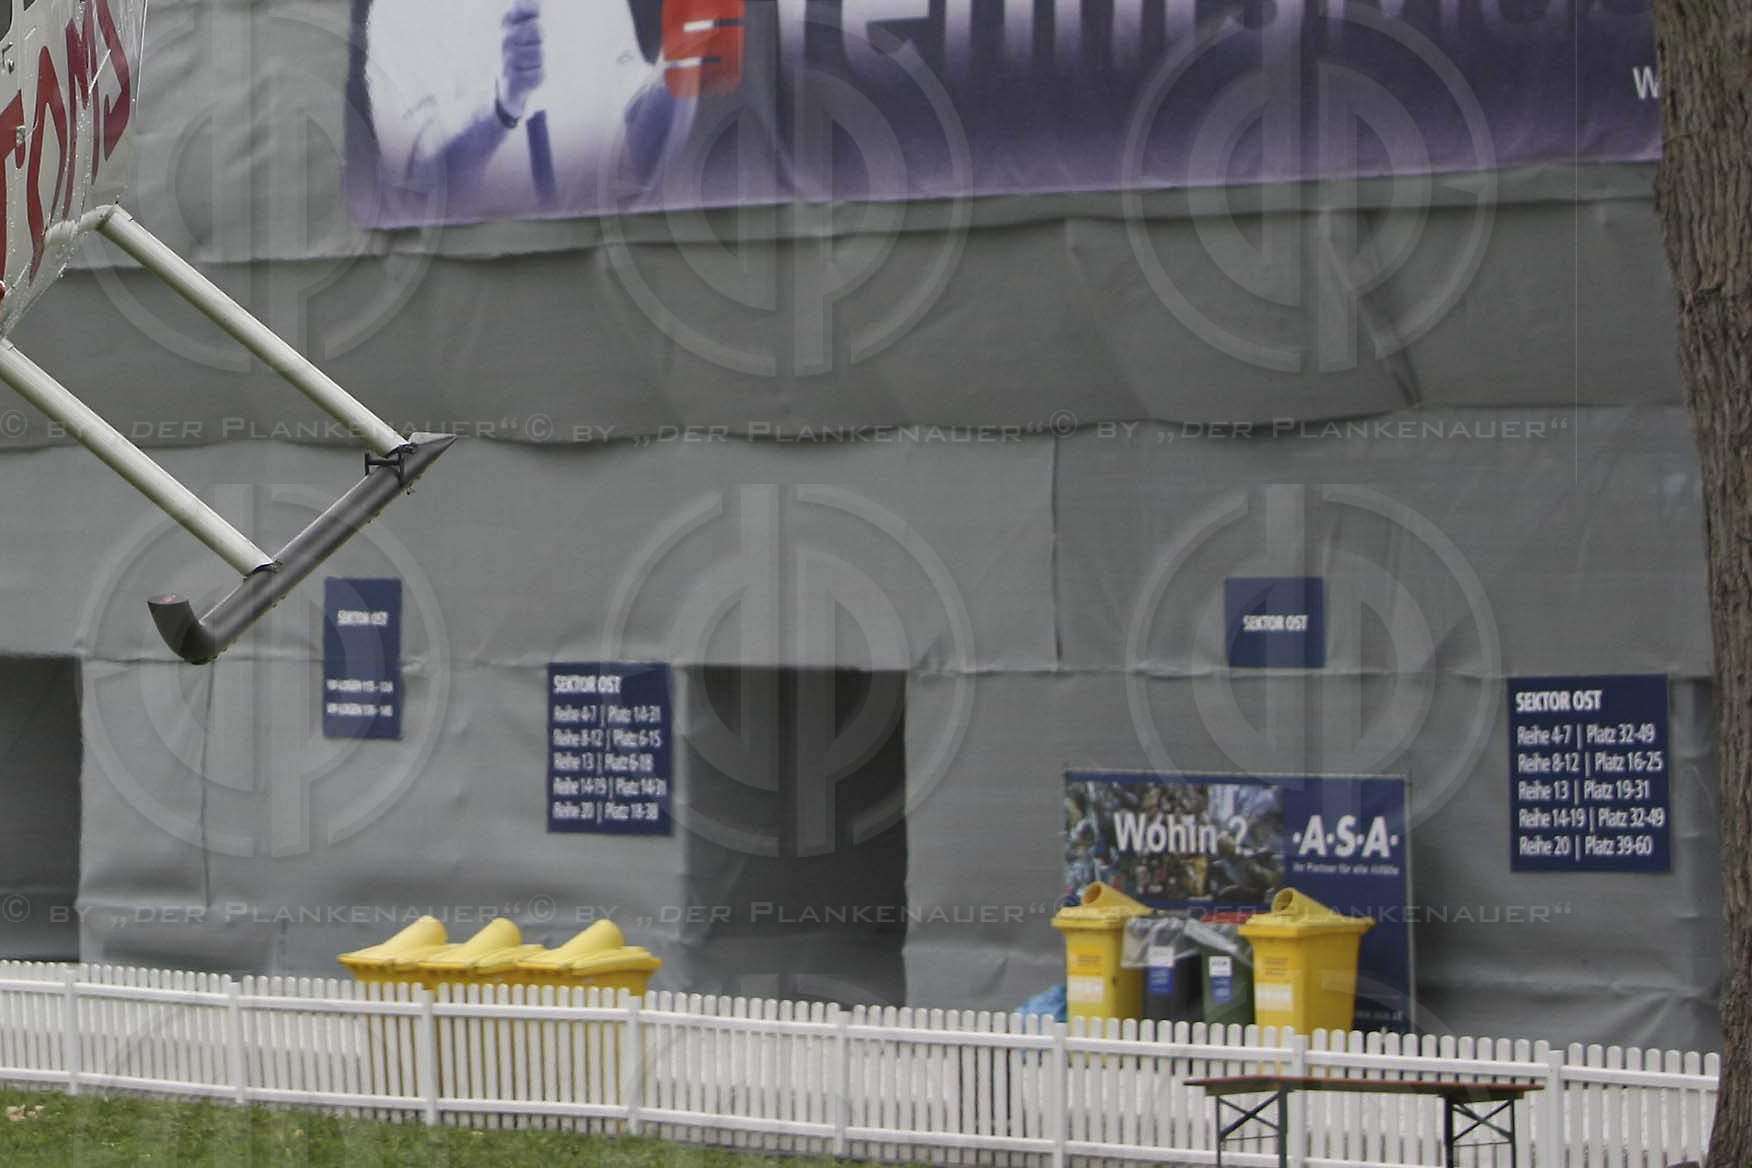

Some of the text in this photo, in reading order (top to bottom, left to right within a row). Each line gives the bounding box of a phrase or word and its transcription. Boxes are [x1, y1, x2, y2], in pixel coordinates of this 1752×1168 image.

[1243, 614, 1309, 632] SEKTOR OST
[553, 675, 622, 693] SEKTOR OST
[1515, 690, 1603, 713] SEKTOR OST
[553, 705, 580, 722] Reihe
[607, 705, 631, 722] Platz
[553, 729, 580, 747] Reihe
[613, 729, 637, 747] Platz
[1517, 723, 1656, 745] Reihe 4-7 Platz 32-49
[553, 752, 580, 770] Reihe
[604, 754, 629, 771] Platz
[1518, 751, 1663, 773] Reihe 8-12 Platz 16-25
[553, 777, 579, 795] Reihe
[615, 778, 640, 796] Platz
[1518, 780, 1650, 800] Reihe 13 Platz 19-31
[553, 801, 580, 819] Reihe
[604, 802, 629, 819] Platz
[1519, 807, 1665, 828] Reihe 14-19 Platz 32-49
[1113, 812, 1218, 854] Wohin
[1519, 835, 1653, 856] Reihe 20 Platz 39-60
